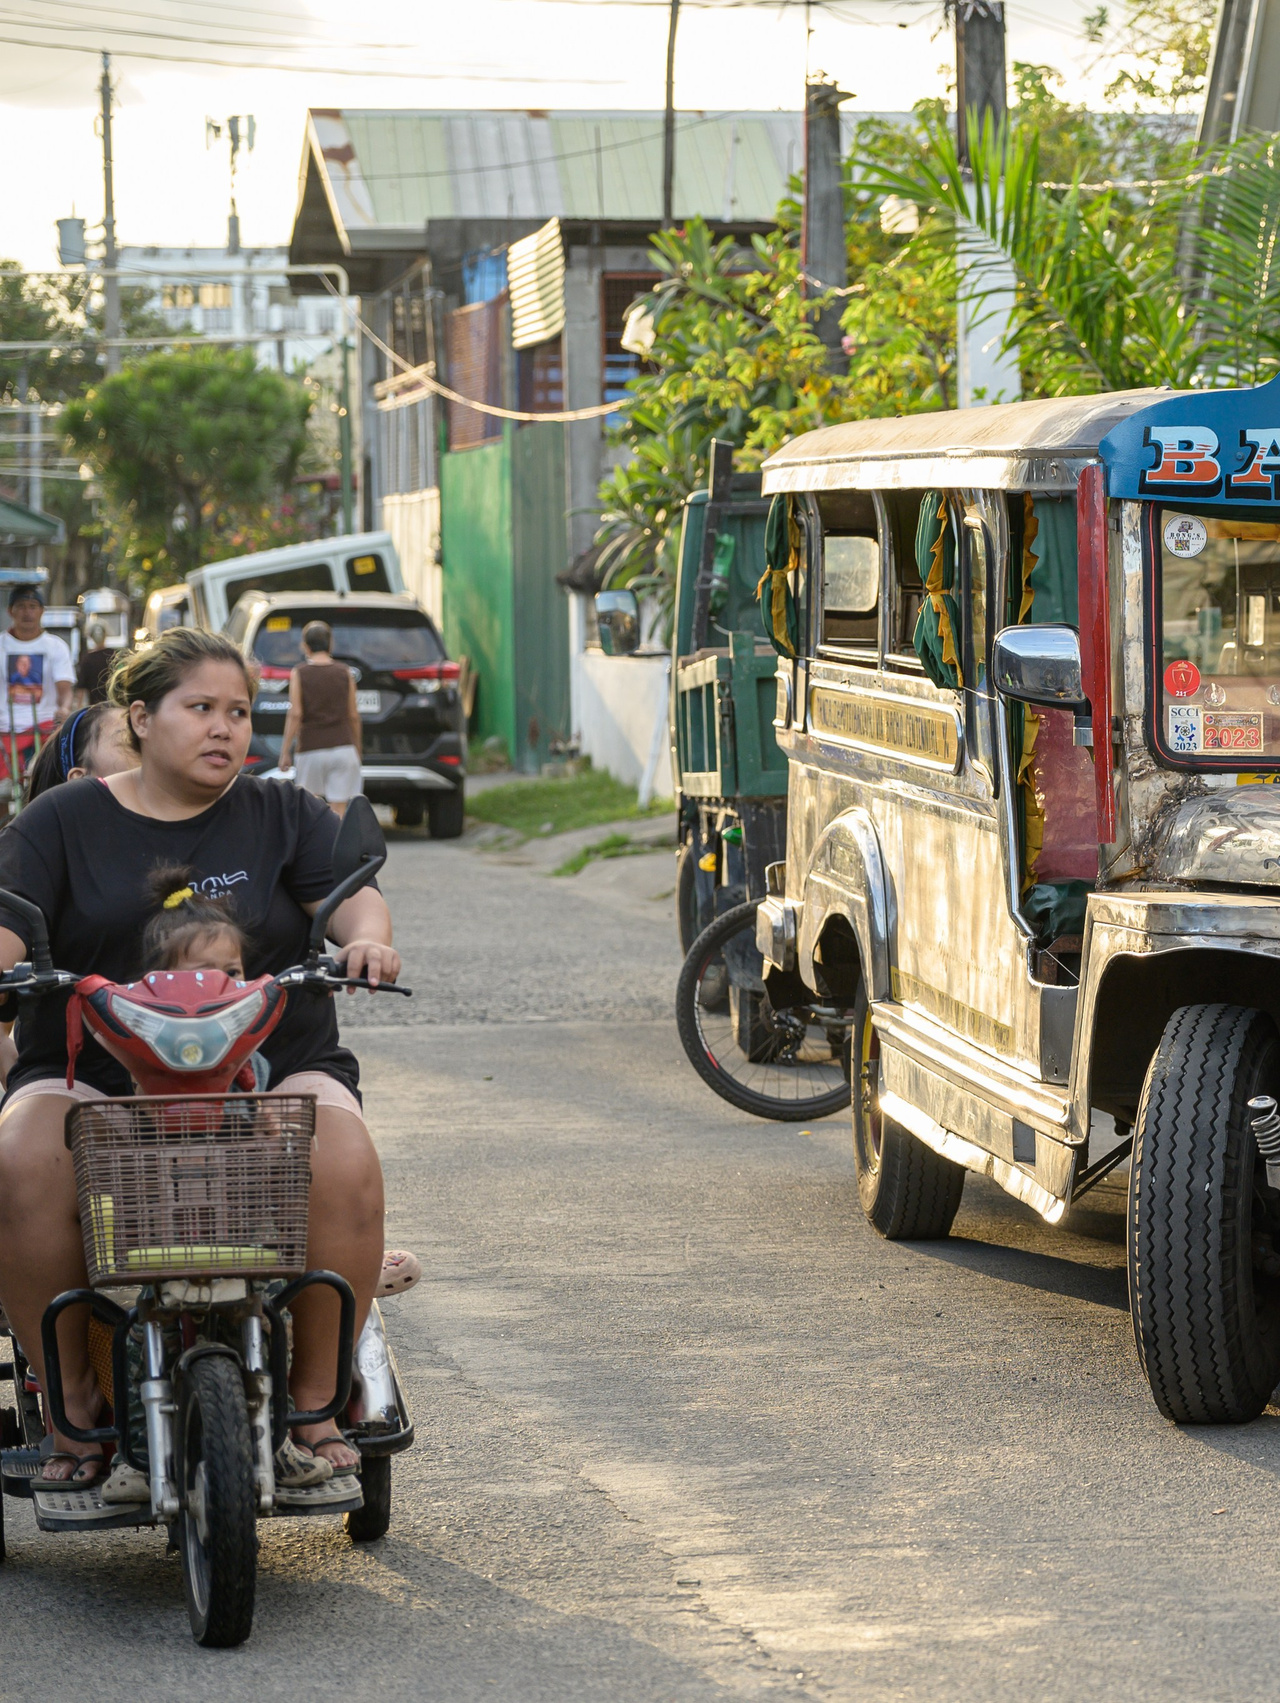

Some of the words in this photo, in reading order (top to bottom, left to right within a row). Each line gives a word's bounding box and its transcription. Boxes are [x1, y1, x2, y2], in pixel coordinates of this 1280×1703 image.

[1171, 708, 1199, 717] SCCI
[1204, 727, 1260, 748] 2023
[1174, 742, 1198, 751] 2023
